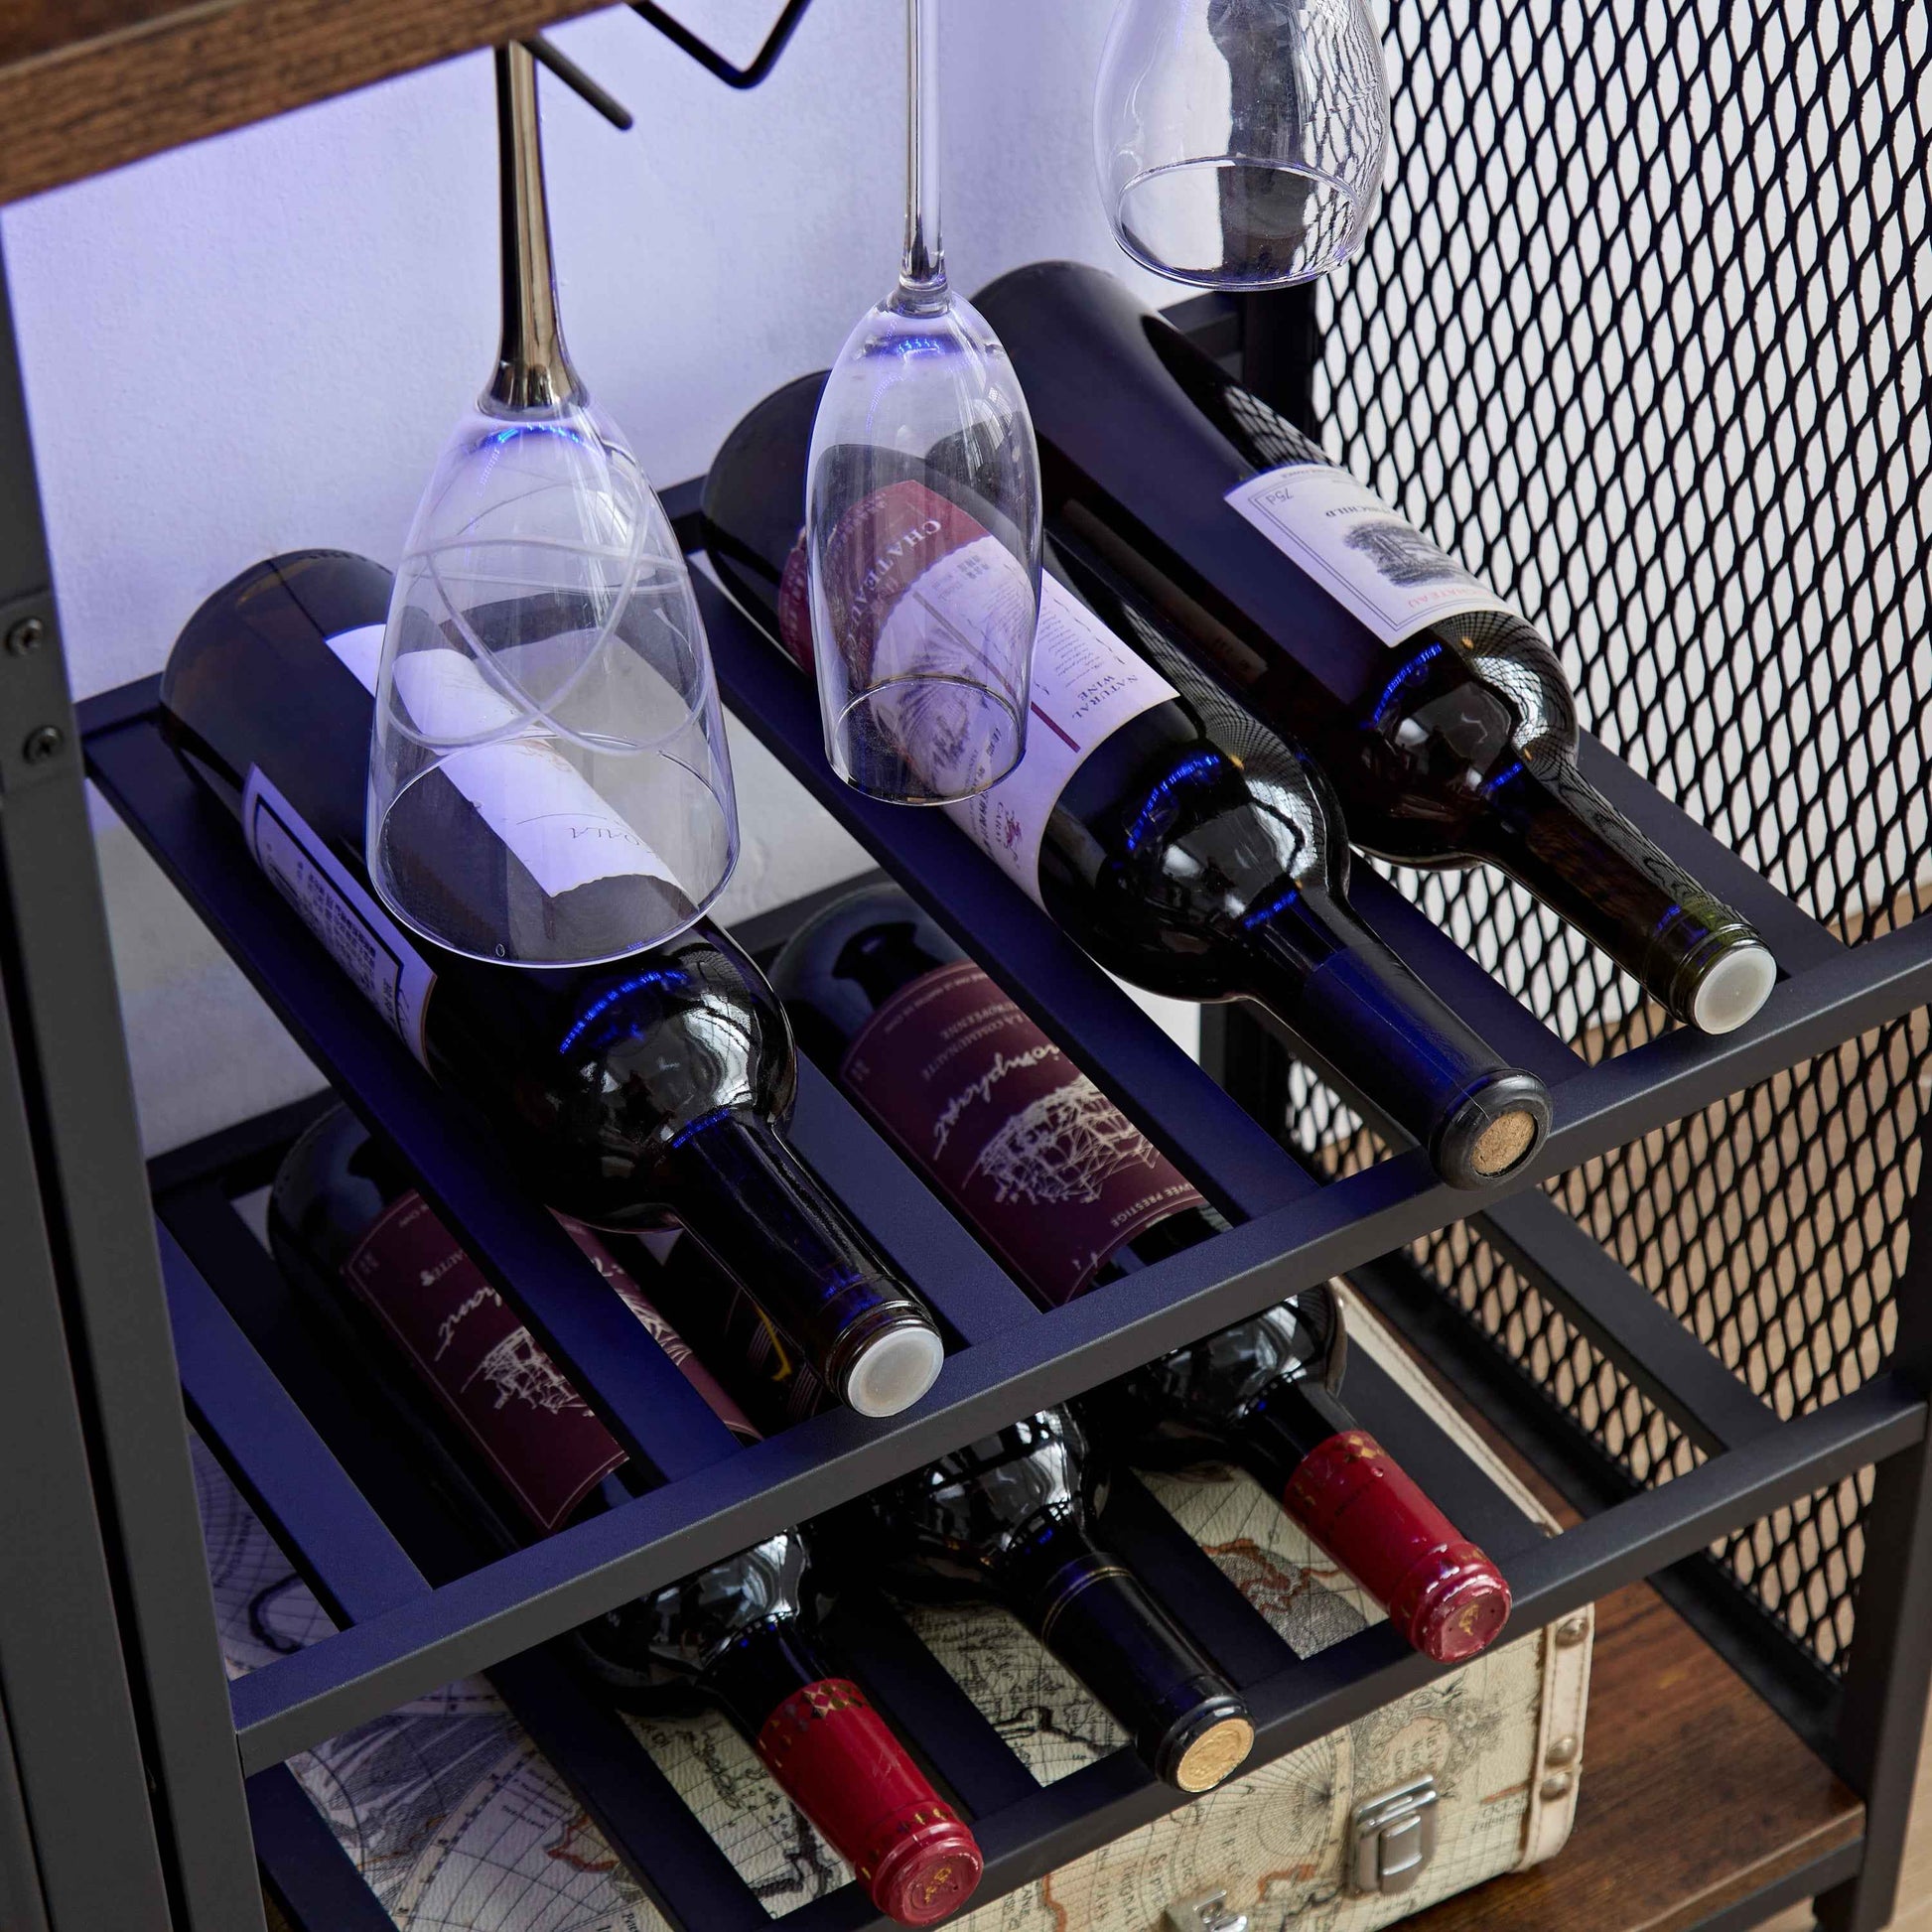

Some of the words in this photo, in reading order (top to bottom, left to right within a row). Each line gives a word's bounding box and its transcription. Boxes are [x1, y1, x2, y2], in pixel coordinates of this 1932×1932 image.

[1070, 673, 1140, 722] NATURAL
[1076, 674, 1118, 702] WINE
[932, 1043, 1062, 1162] iomphant
[1108, 1193, 1160, 1229] PRESTIGE
